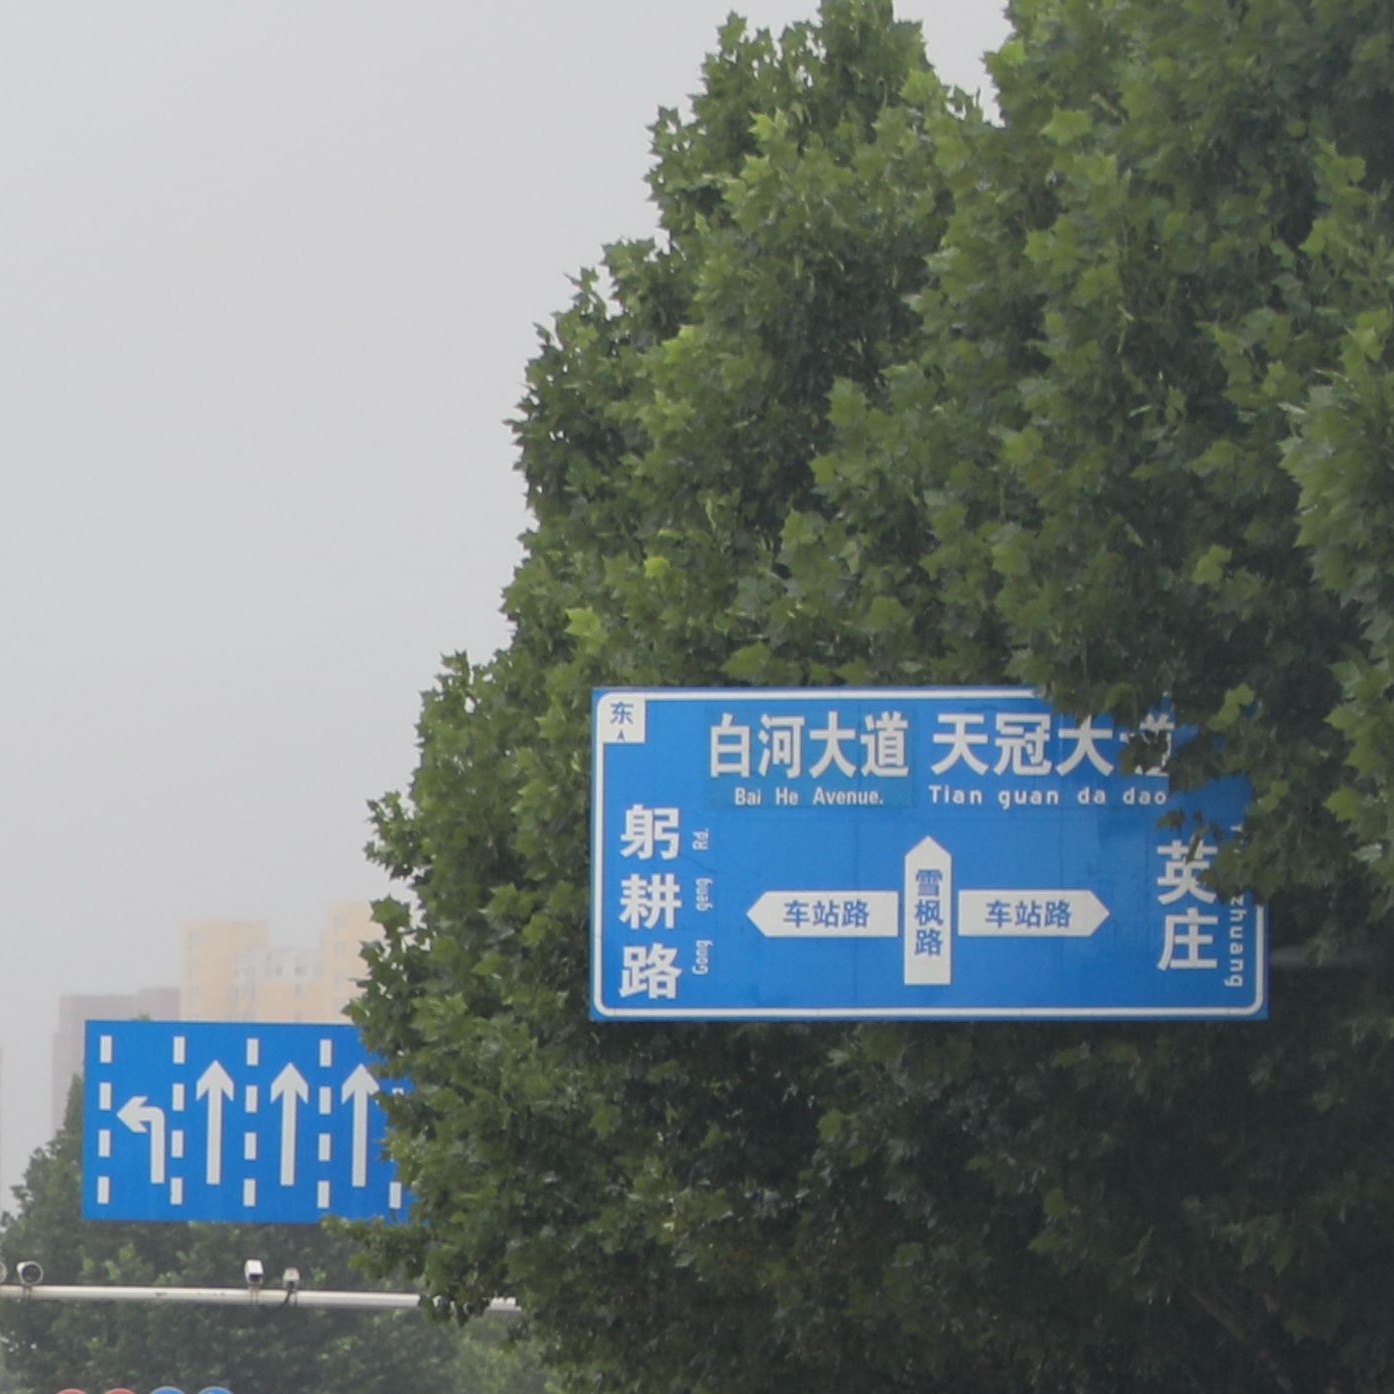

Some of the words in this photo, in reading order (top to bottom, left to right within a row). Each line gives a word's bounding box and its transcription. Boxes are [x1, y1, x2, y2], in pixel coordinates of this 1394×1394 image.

[611, 702, 634, 725] 东
[710, 711, 909, 779] 白河大道
[735, 787, 761, 805] Bai
[776, 787, 799, 805] He
[813, 787, 883, 805] Avenue.
[928, 784, 983, 805] Tian
[998, 787, 1059, 809] guan
[1077, 786, 1106, 805] da
[1122, 786, 1167, 805] dao
[692, 828, 709, 850] Rd.
[619, 804, 682, 1000] 躬耕路
[695, 877, 713, 912] geng
[1157, 839, 1219, 971] 英庄
[782, 900, 870, 928] 车站路
[914, 868, 944, 957] 雪枫路
[984, 900, 1073, 928] 车站路
[692, 940, 712, 975] Gong
